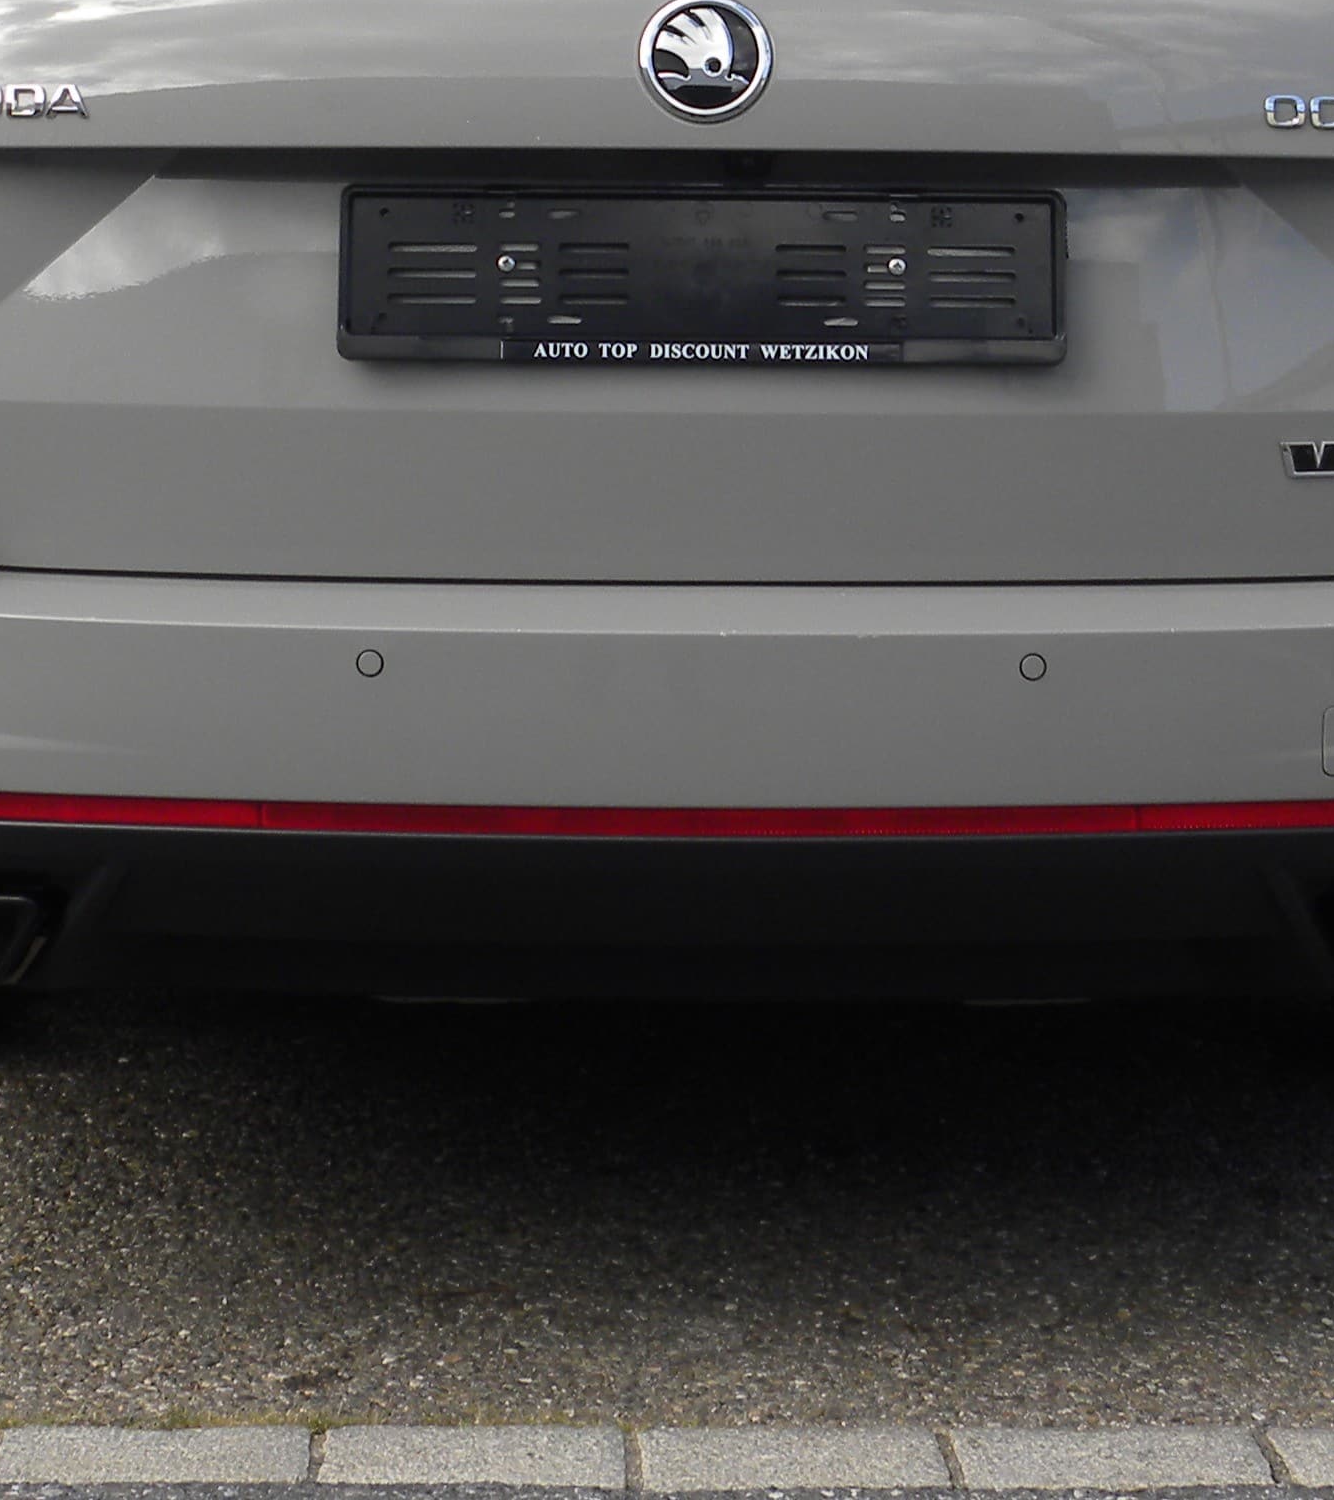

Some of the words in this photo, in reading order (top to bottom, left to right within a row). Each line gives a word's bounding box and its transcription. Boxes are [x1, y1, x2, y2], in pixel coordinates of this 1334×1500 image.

[534, 342, 588, 360] AUTO
[599, 342, 638, 360] TOP
[650, 343, 749, 361] DISCOUNT
[759, 344, 868, 362] WETZIKON
